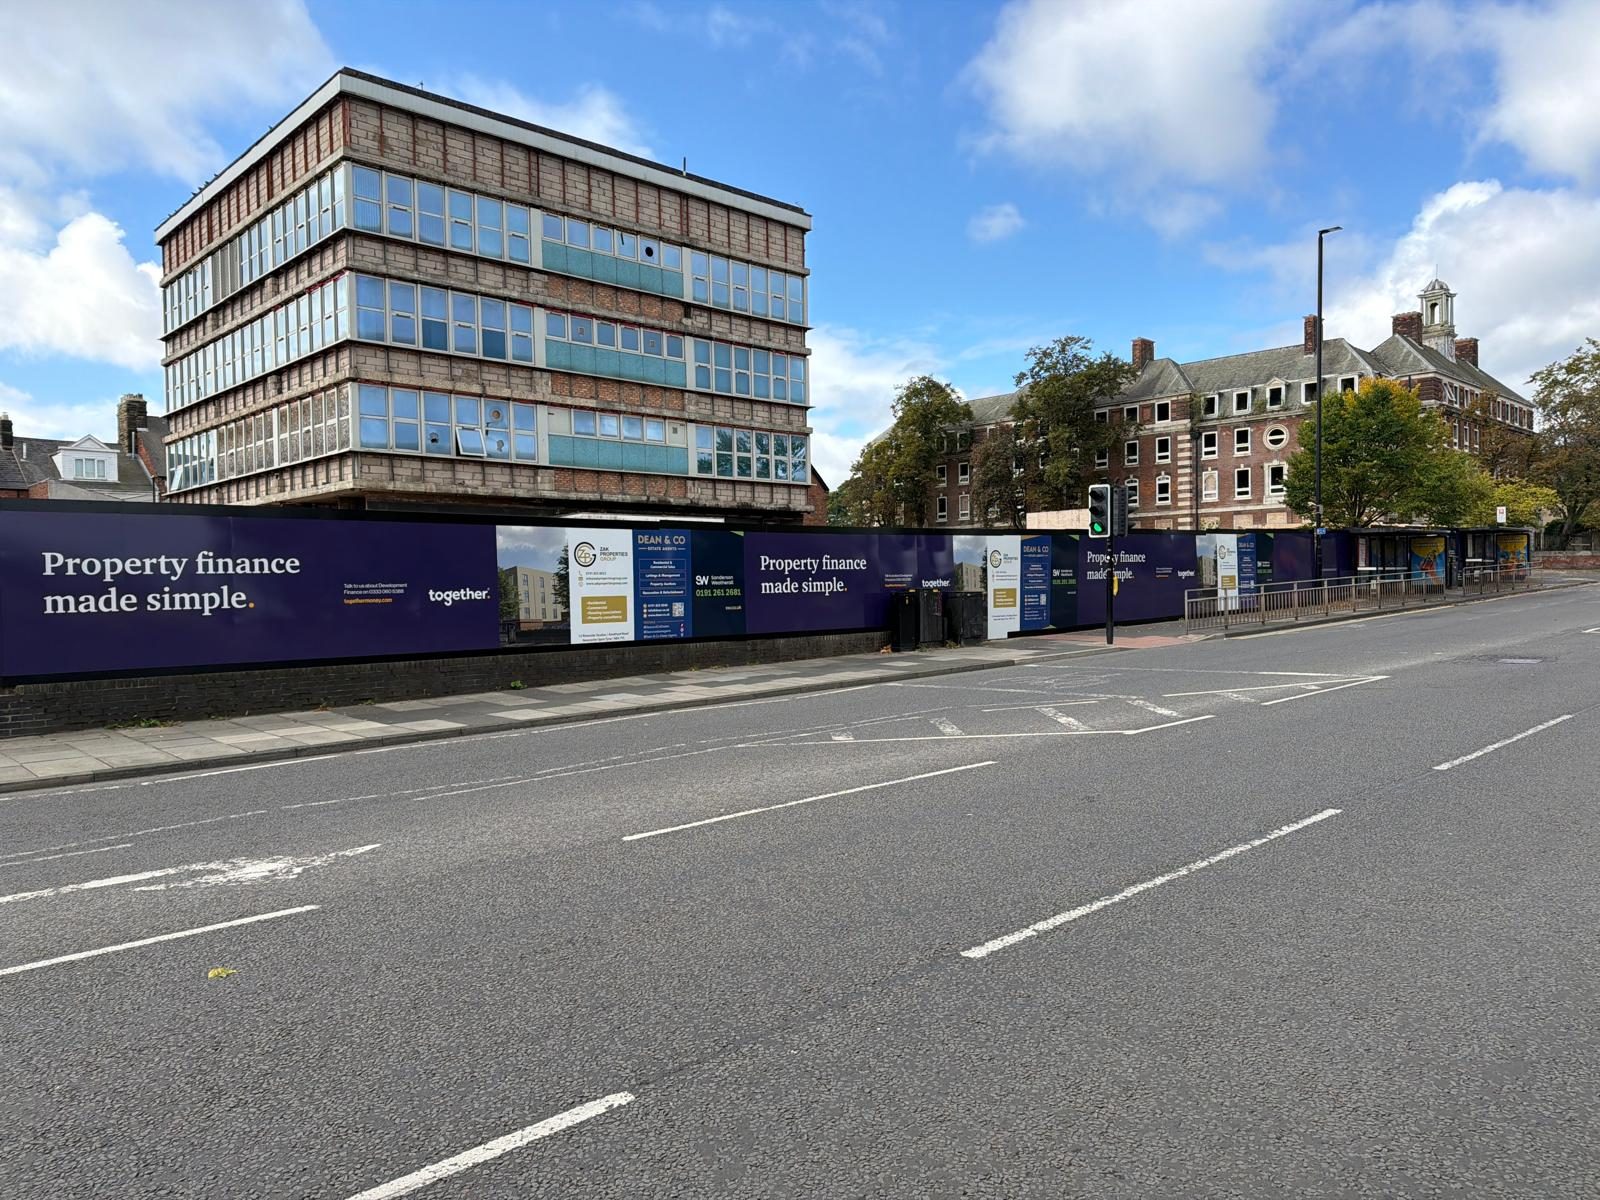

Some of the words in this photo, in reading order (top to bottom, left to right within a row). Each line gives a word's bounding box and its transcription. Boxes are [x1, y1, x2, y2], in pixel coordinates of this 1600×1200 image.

[638, 534, 662, 545] DEAN
[664, 536, 671, 545] &
[673, 535, 686, 545] CO
[1120, 551, 1146, 563] finance
[42, 552, 188, 582] Property
[196, 551, 300, 575] finance
[760, 555, 819, 575] Property
[822, 554, 867, 571] finance
[1087, 567, 1108, 579] made
[696, 575, 709, 586] SW
[761, 577, 799, 594] made
[801, 576, 848, 597] simple.
[696, 589, 712, 597] 0191
[712, 589, 725, 597] 261
[725, 588, 742, 597] 2681
[43, 587, 138, 614] made
[146, 585, 255, 616] simple.
